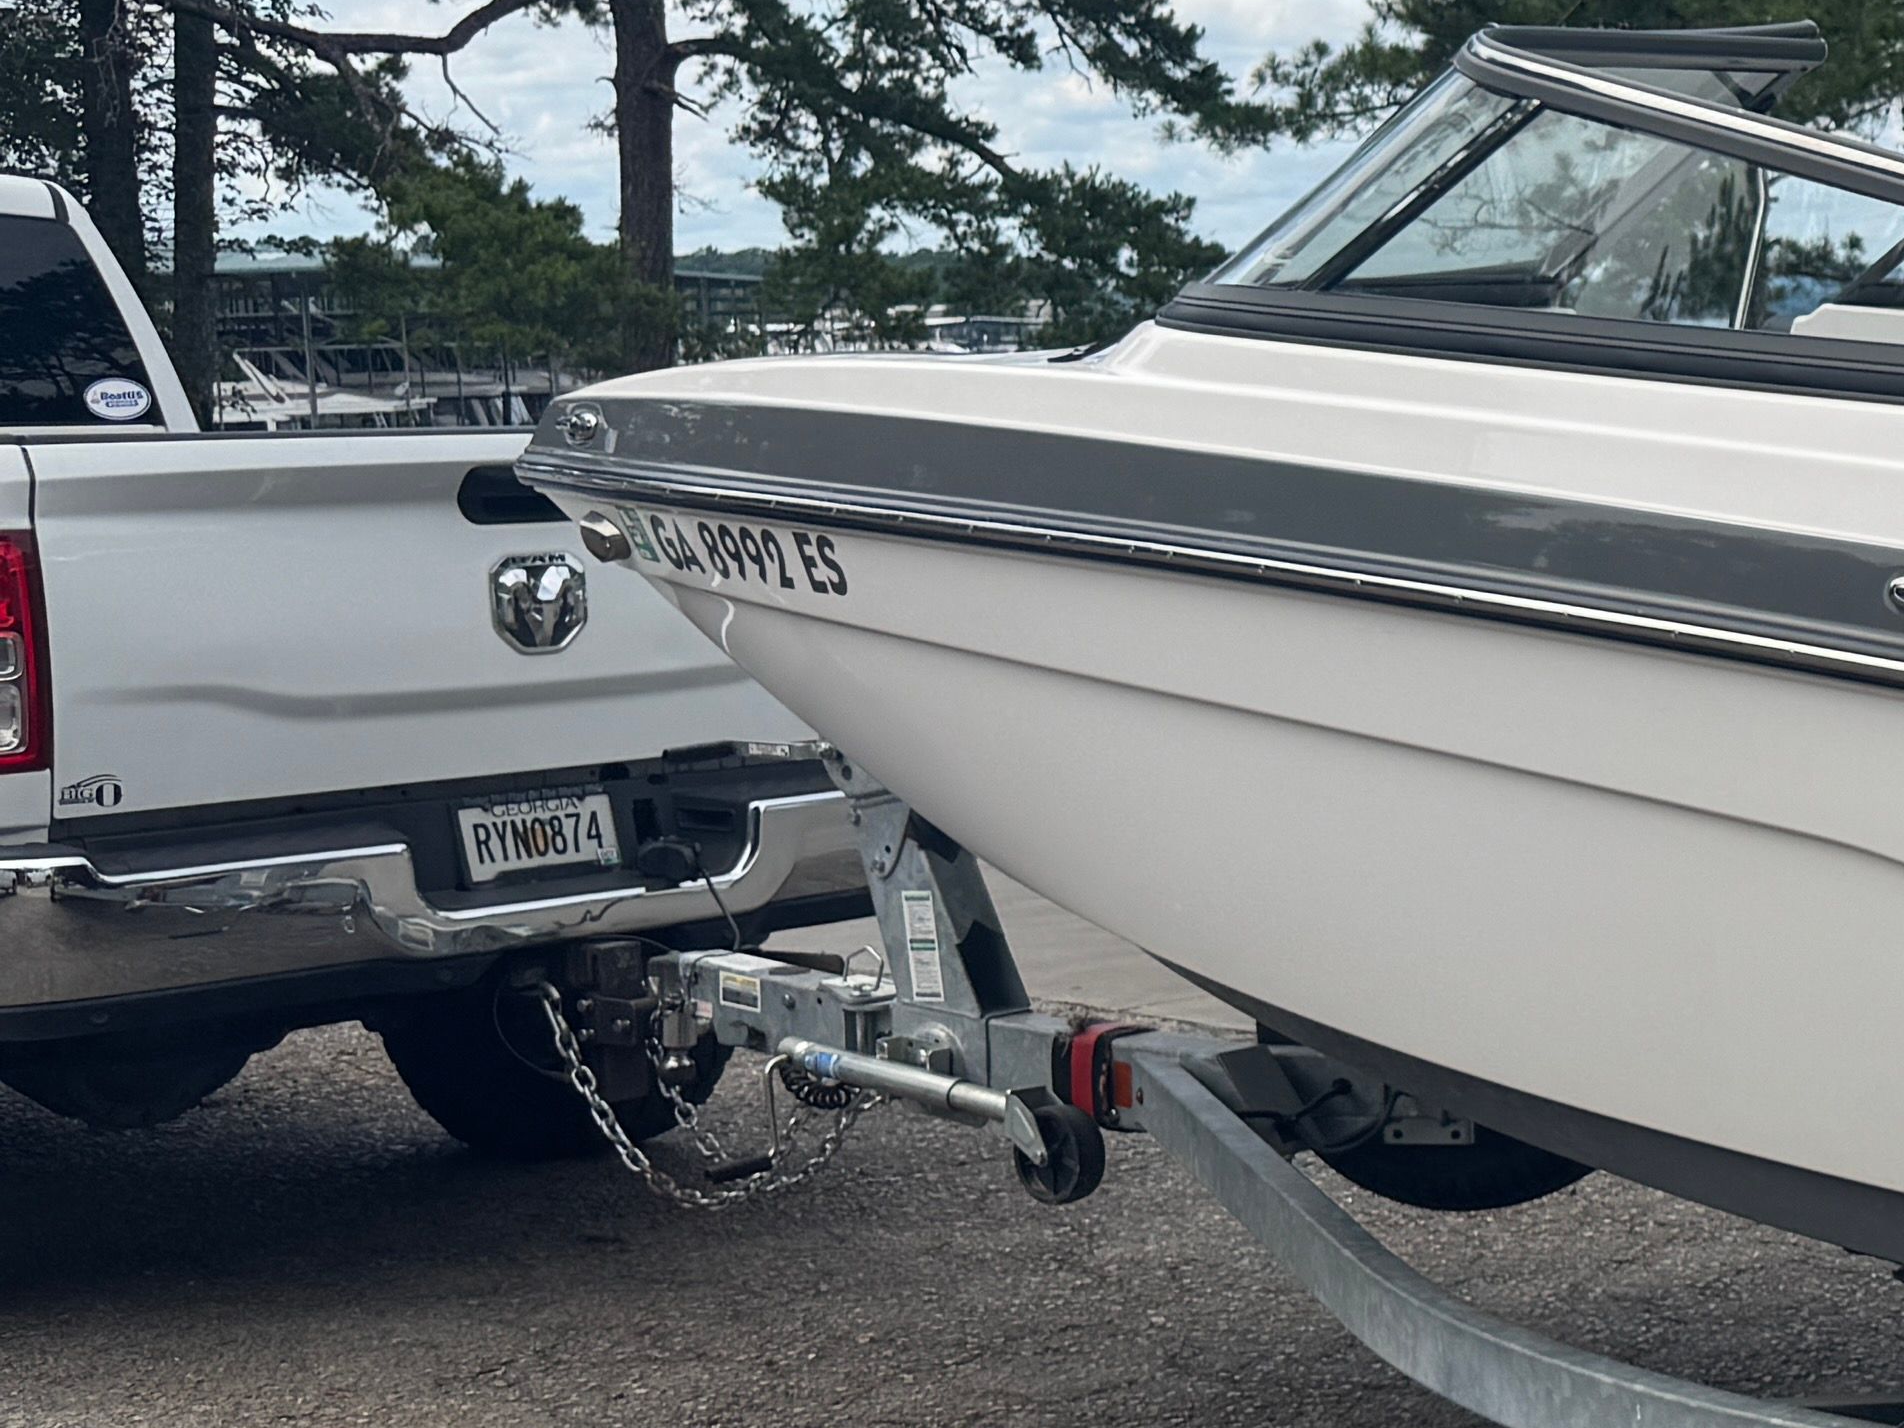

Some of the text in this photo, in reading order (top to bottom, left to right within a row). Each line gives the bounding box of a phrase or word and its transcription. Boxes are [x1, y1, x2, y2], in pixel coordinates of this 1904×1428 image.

[650, 514, 706, 574] GA
[697, 521, 796, 590] 8992
[792, 531, 848, 596] ES
[491, 797, 579, 818] GEORGIA
[472, 810, 603, 865] RYN0874
